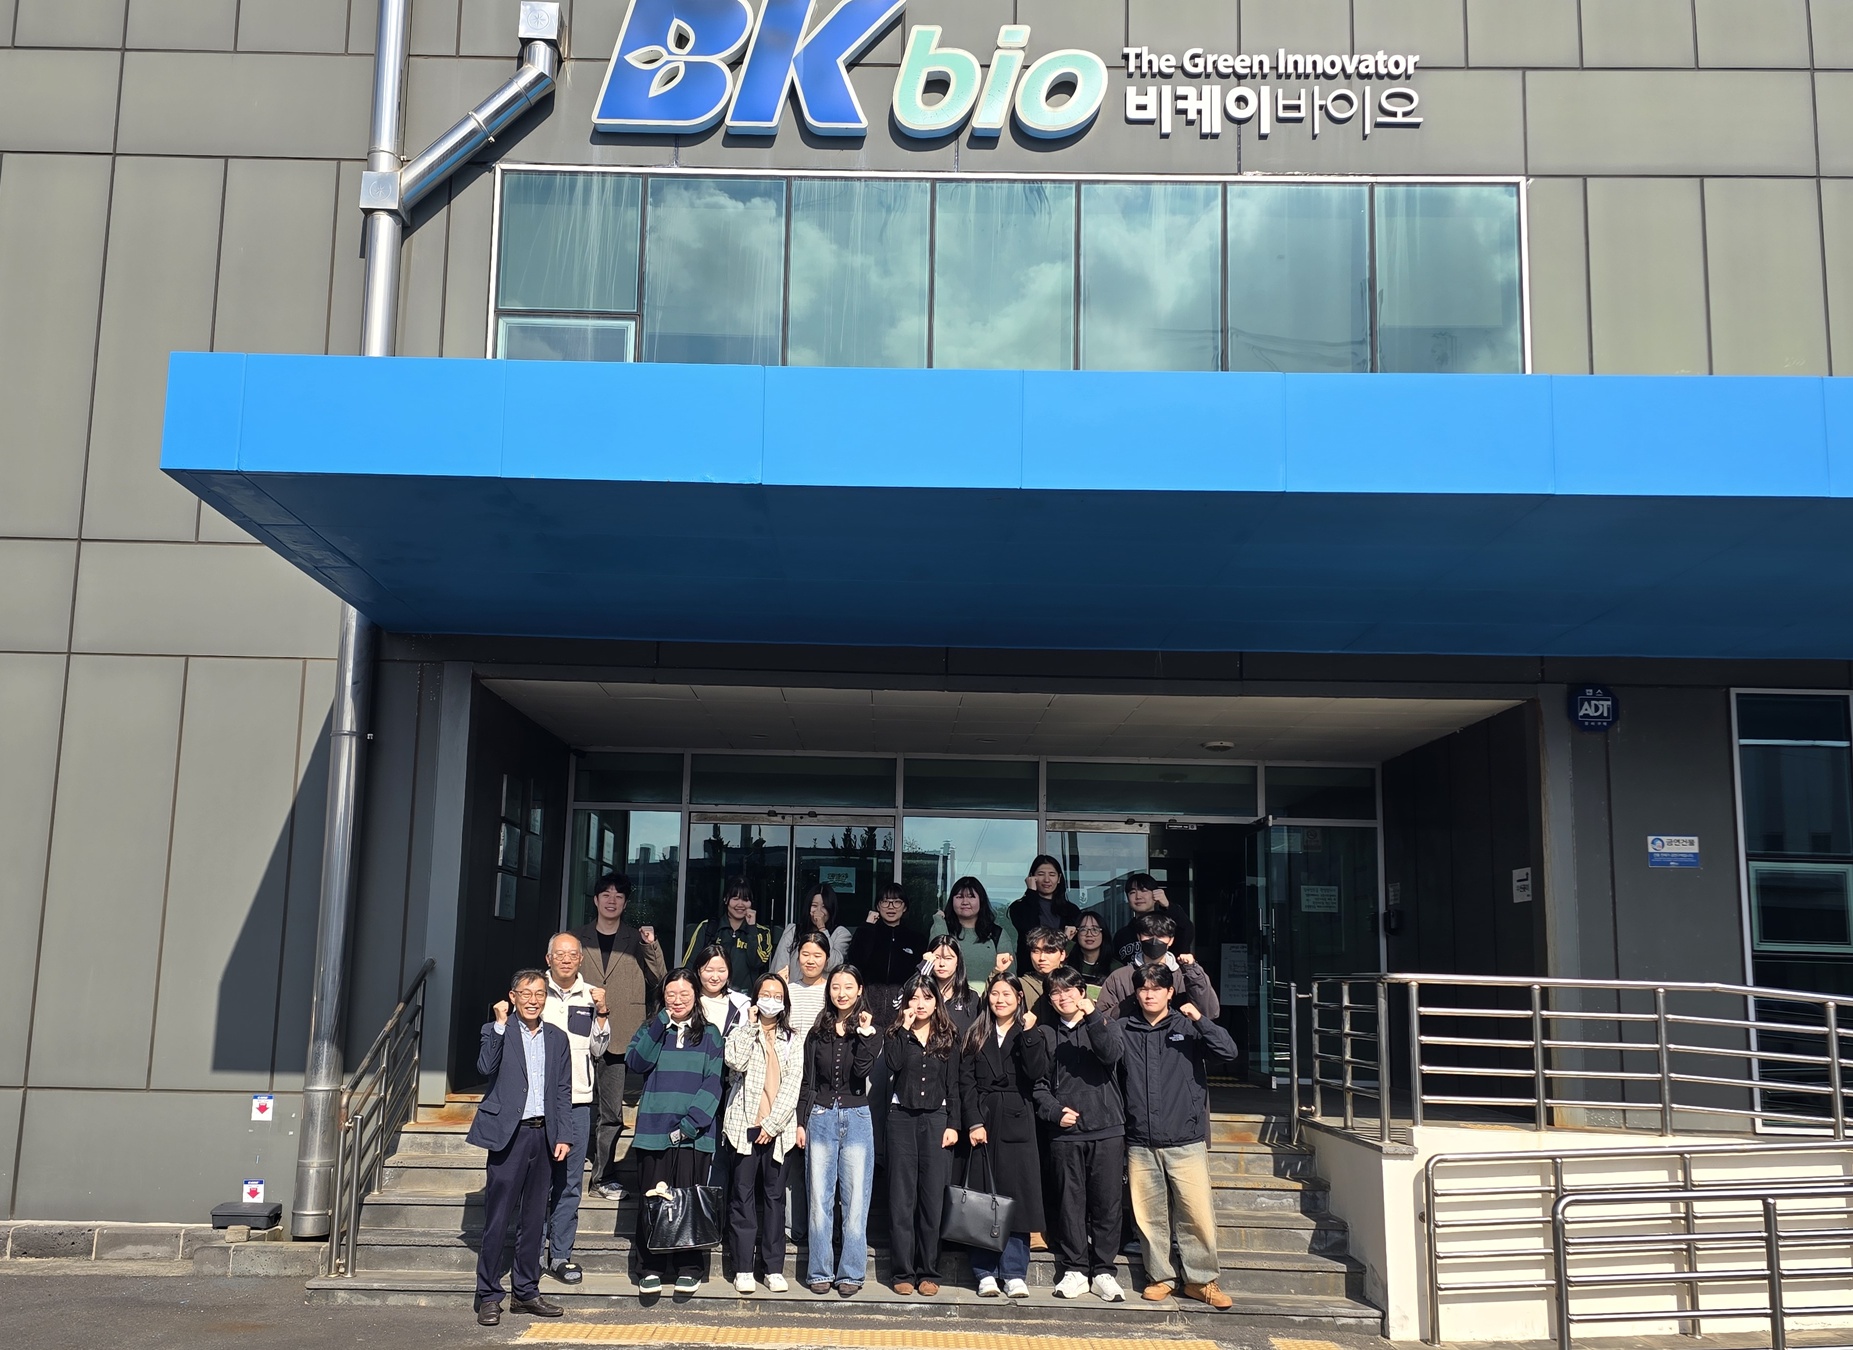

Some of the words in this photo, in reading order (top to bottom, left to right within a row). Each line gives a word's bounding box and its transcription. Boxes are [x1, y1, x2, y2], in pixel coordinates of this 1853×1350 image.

[591, 0, 906, 136] BK
[892, 24, 1108, 139] bio
[1122, 46, 1175, 76] The
[1182, 47, 1270, 77] Green
[1276, 48, 1420, 77] Innovator
[1125, 84, 1424, 137] 비케이바이오
[1578, 700, 1612, 717] ADT
